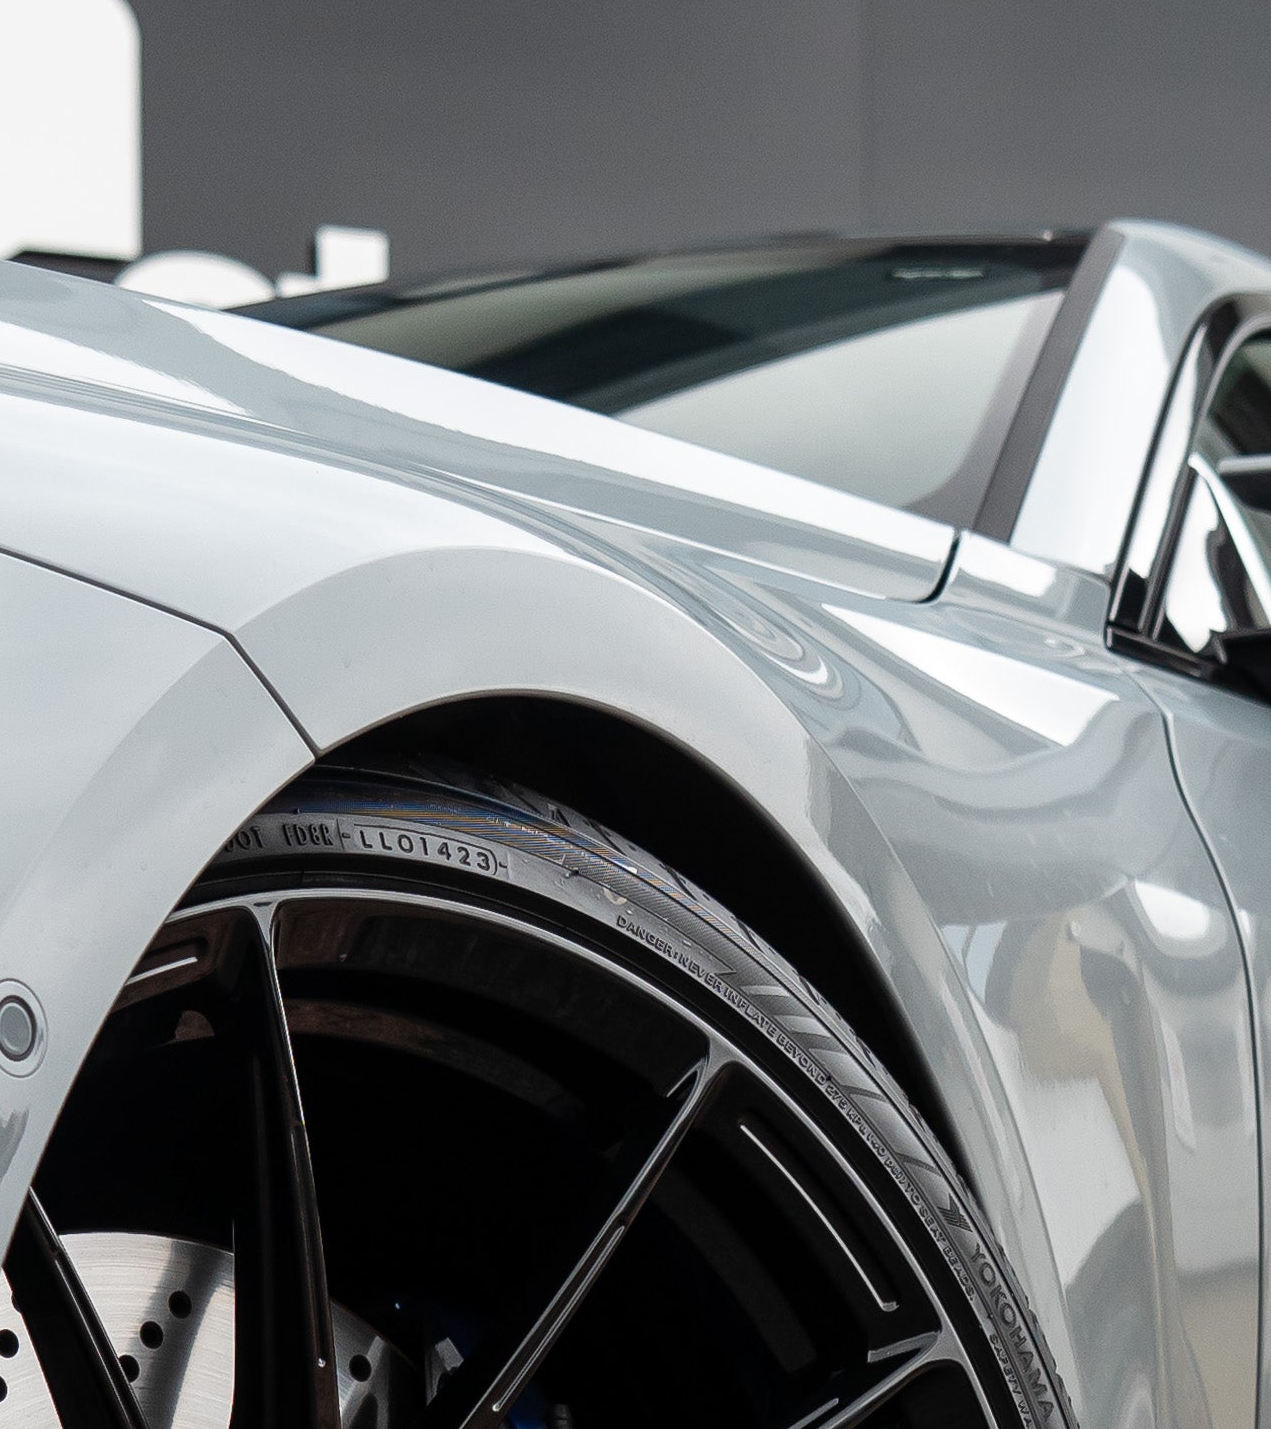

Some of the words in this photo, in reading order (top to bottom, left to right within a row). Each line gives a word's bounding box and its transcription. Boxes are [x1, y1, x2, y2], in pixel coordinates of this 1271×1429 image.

[676, 951, 725, 994] NEVER
[722, 985, 778, 1039] INFLATE
[774, 1031, 828, 1087] BEYOND
[917, 1203, 947, 1246] SEAT
[970, 1242, 1055, 1422] YOKOHAMA
[987, 1331, 1022, 1397] SAFETY
